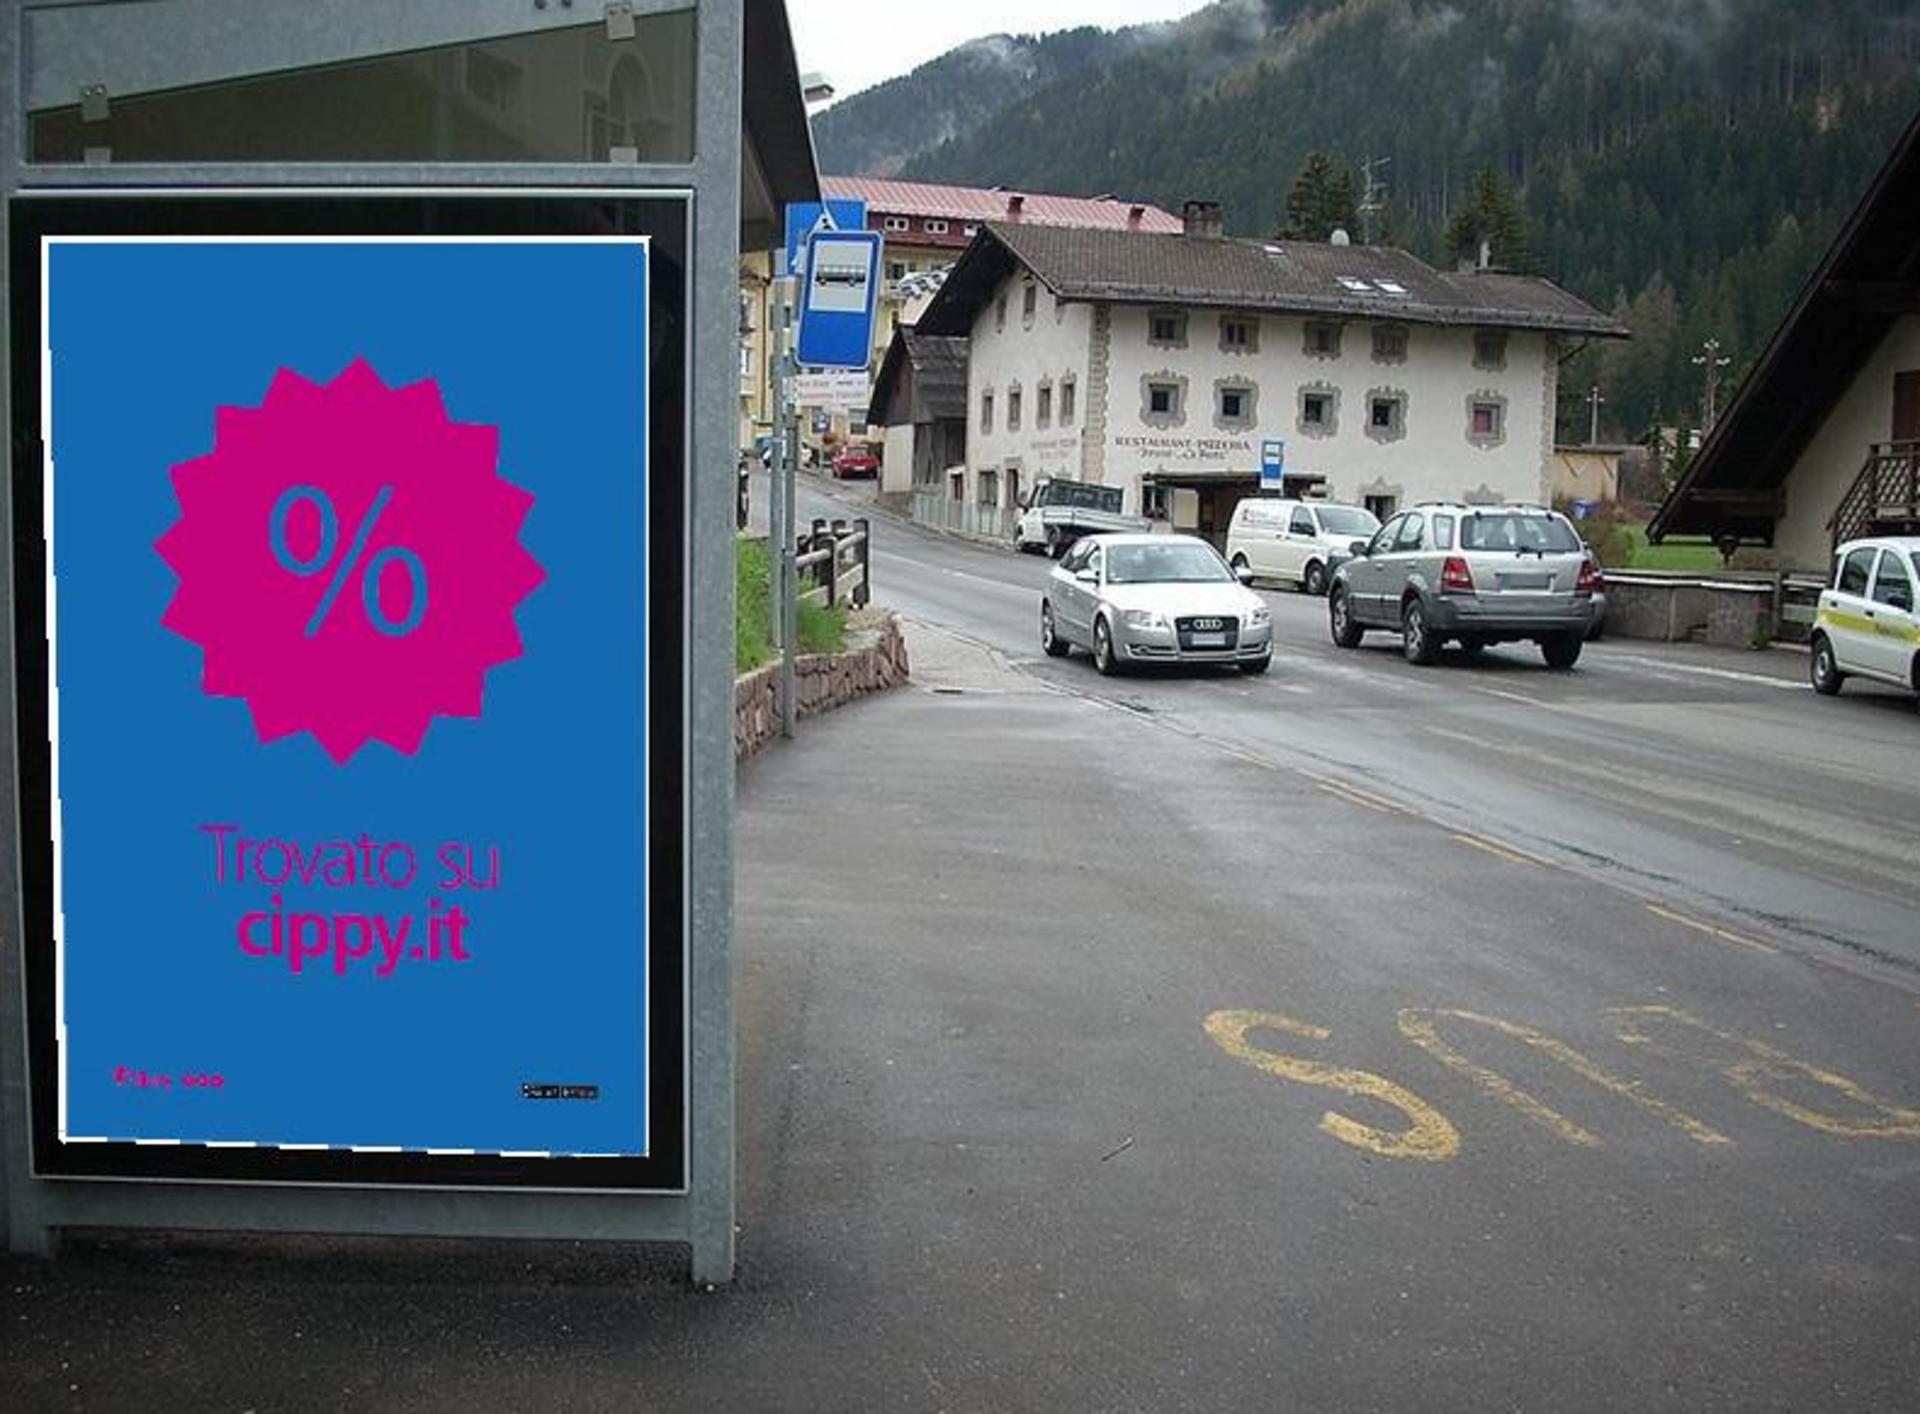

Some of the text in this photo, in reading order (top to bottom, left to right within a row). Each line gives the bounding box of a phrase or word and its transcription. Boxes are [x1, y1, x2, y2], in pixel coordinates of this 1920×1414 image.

[267, 484, 430, 639] %
[200, 823, 500, 890] Trovato su
[237, 894, 470, 978] cippy.it
[1203, 1005, 1920, 1161] BUS
